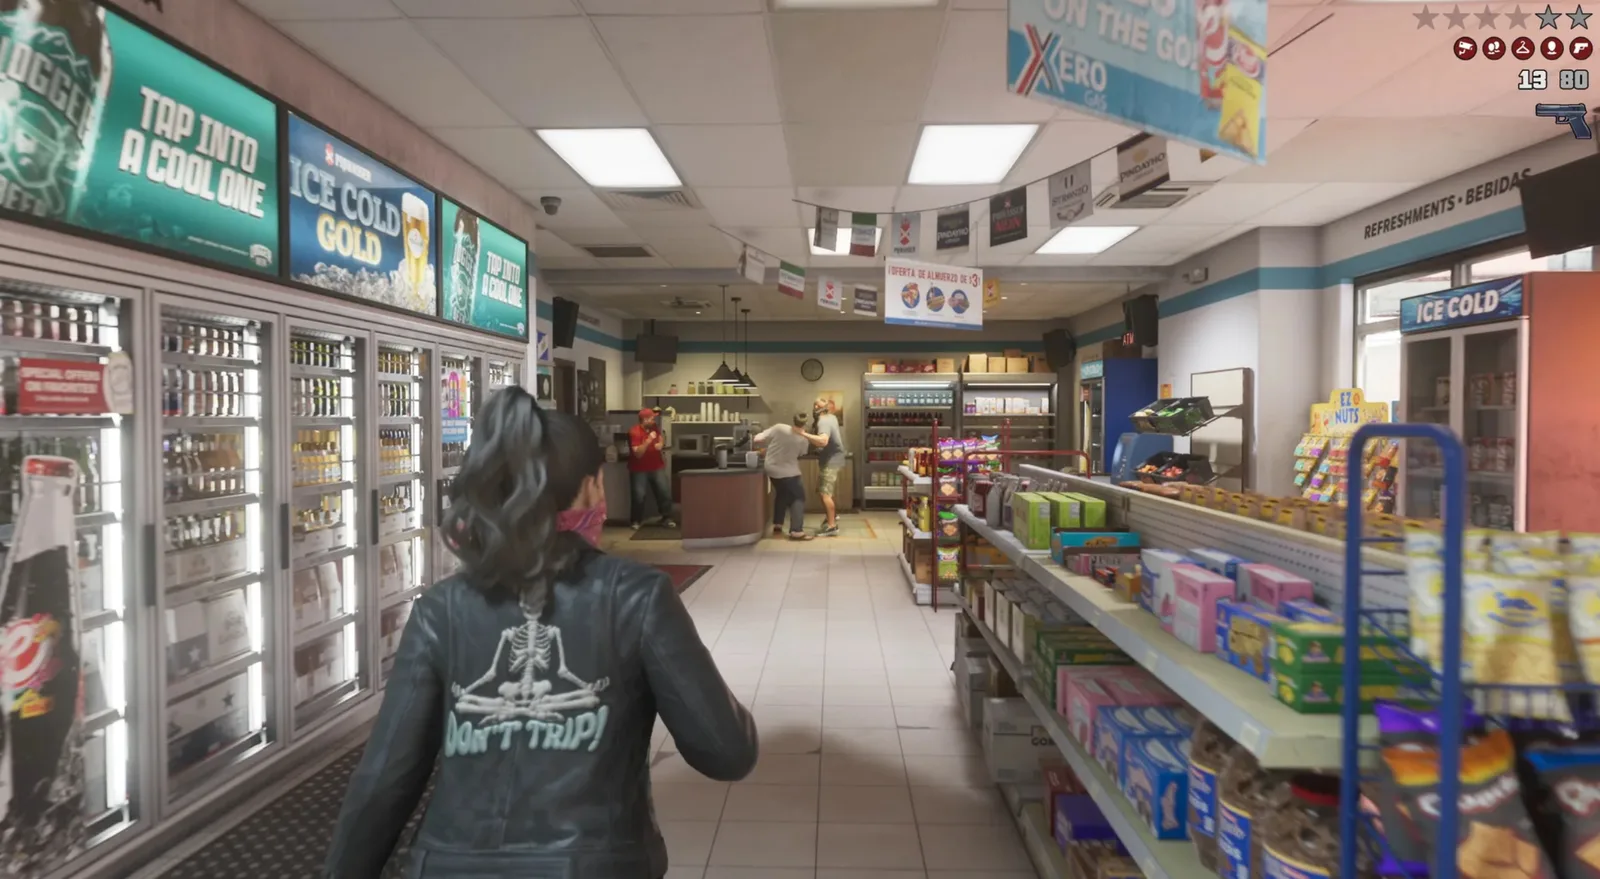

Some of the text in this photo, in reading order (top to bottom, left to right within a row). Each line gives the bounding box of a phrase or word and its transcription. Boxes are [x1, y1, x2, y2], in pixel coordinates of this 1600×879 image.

[1097, 4, 1149, 52] THE
[1014, 22, 1107, 96] XERO
[1083, 89, 1108, 112] GAS
[140, 85, 259, 174] TAP INTO
[118, 127, 266, 219] A COOL ONE
[289, 158, 336, 212] ICE
[340, 181, 401, 237] COLD
[1363, 194, 1456, 240] REFRESHMENTS
[316, 213, 382, 266] GOLD
[487, 250, 503, 276] TAP
[918, 269, 926, 279] DE
[960, 274, 967, 284] DE
[1416, 289, 1500, 324] ICE COLD
[1123, 332, 1134, 345] ATM
[1335, 407, 1359, 425] NUTS
[1340, 391, 1352, 407] EZ
[445, 705, 609, 758] DON'T TRIP!
